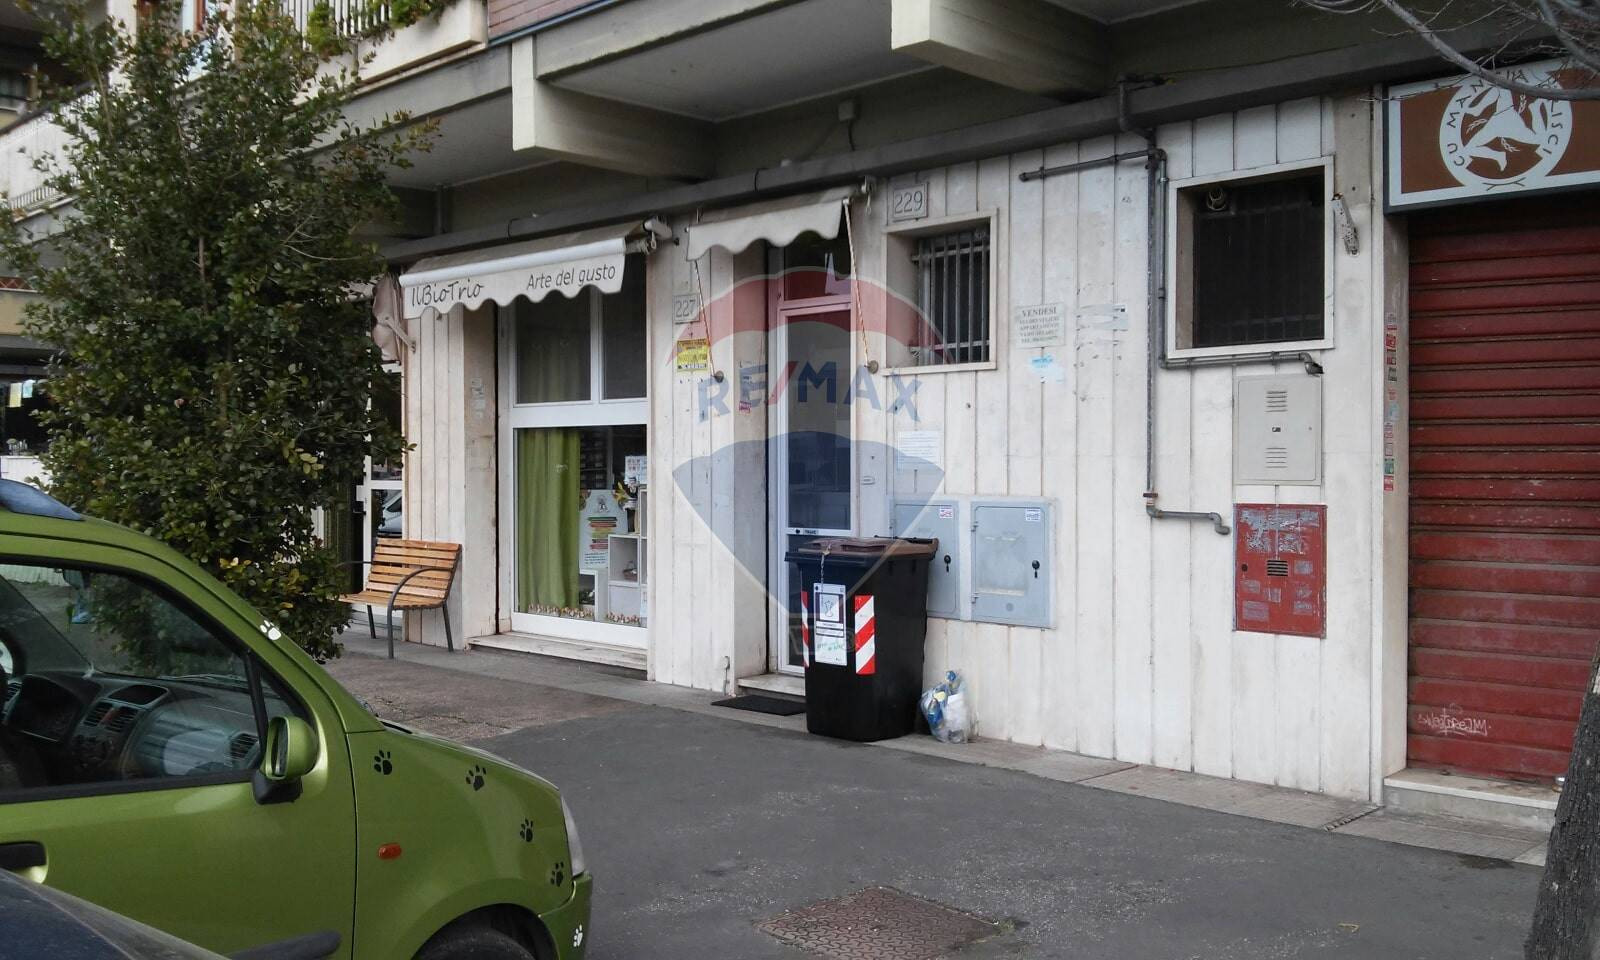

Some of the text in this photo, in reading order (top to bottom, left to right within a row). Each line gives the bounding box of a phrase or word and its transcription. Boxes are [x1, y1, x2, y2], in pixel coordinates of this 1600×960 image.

[894, 190, 924, 215] 229
[527, 263, 616, 290] Arte del gusto
[675, 299, 696, 318] 227
[1021, 306, 1057, 318] VENDESI
